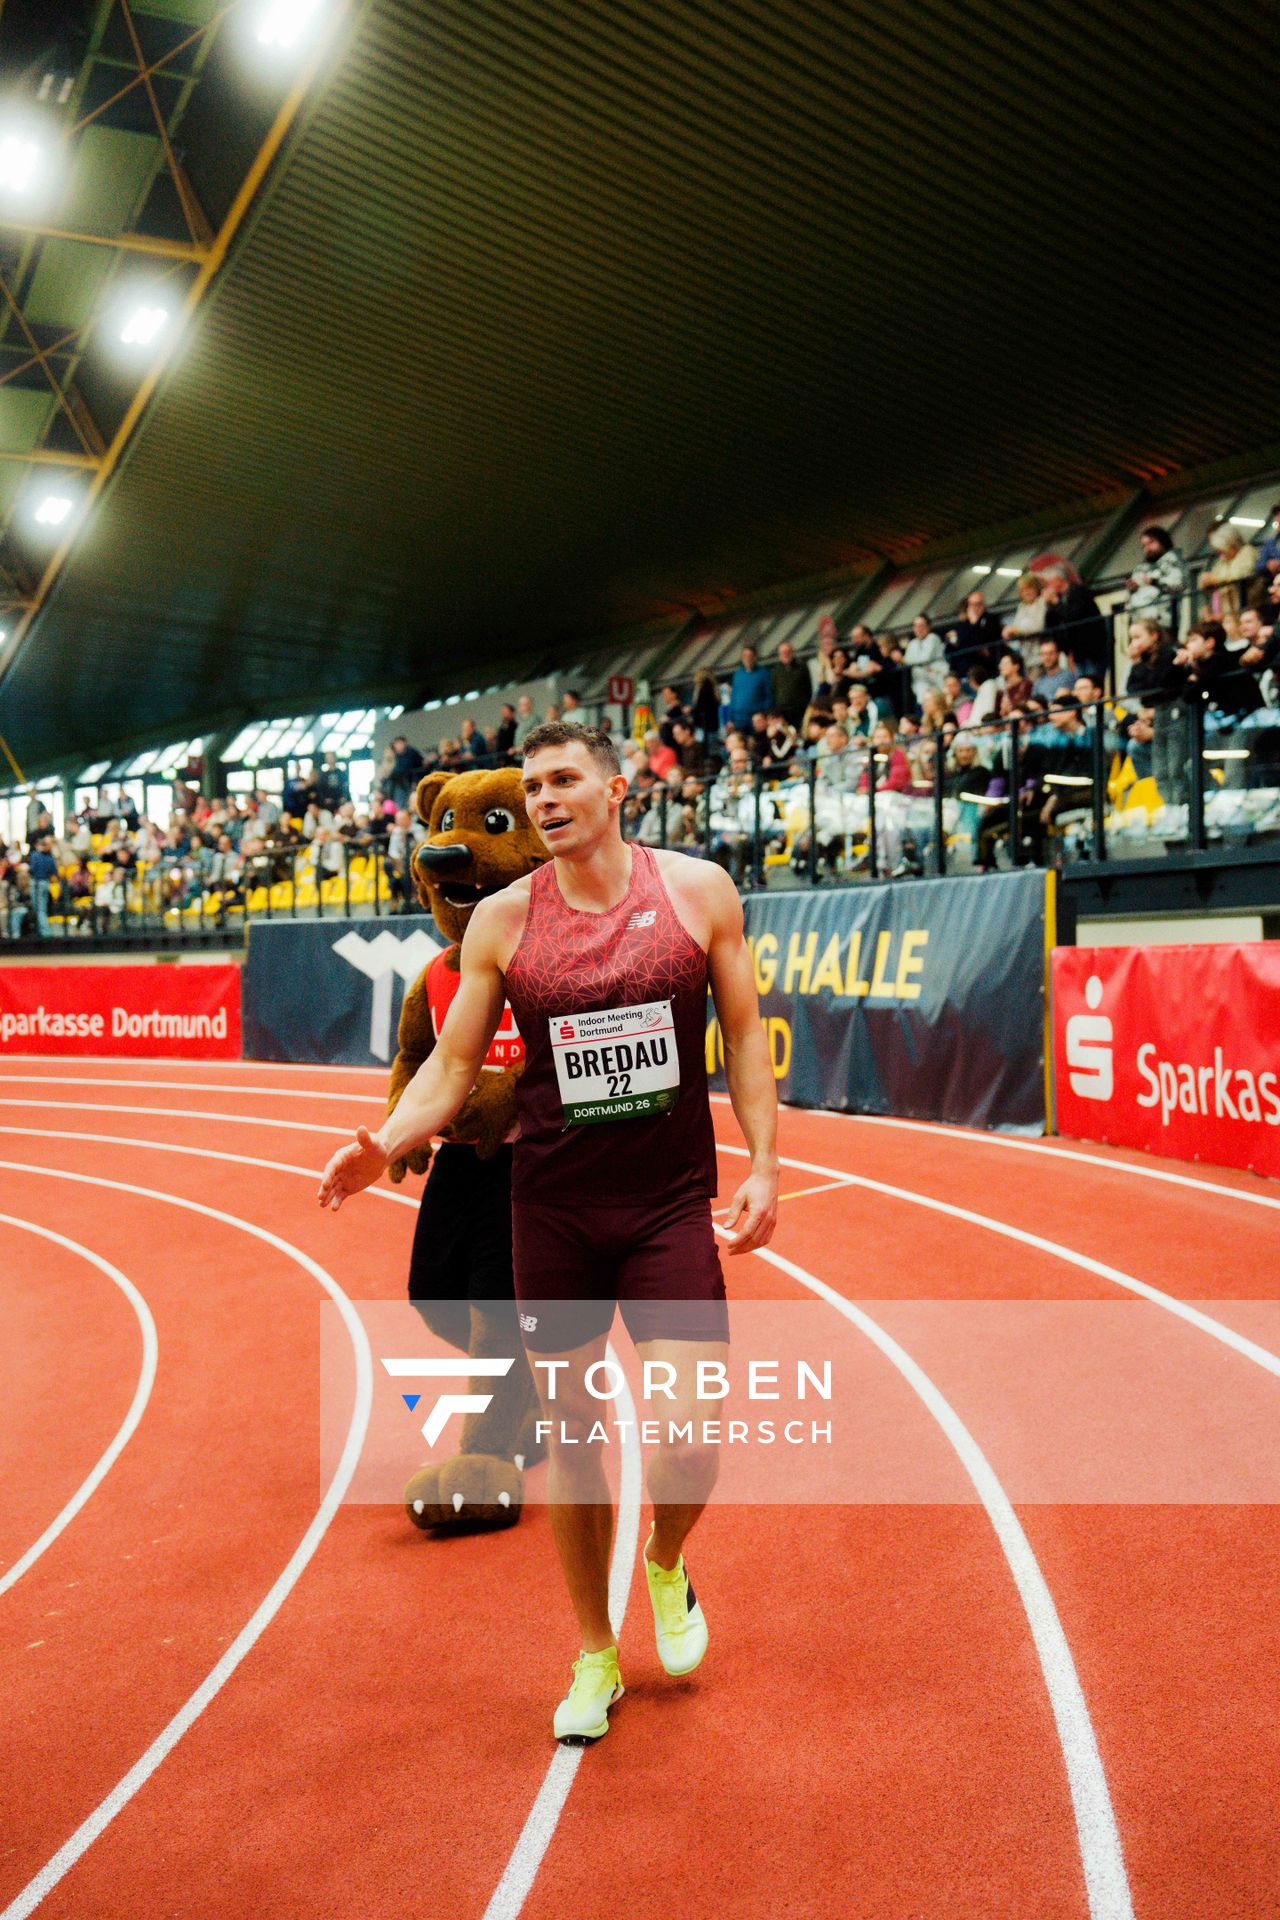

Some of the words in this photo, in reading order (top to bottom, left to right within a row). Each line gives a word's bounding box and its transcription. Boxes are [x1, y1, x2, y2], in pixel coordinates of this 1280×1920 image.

[784, 930, 930, 999] HALLE
[0, 1005, 105, 1043] parkasse
[111, 1006, 227, 1039] Dortmund
[578, 1016, 606, 1027] Indoor
[607, 1010, 643, 1023] Meeting
[580, 1024, 624, 1037] Dortmund
[564, 1037, 668, 1080] BREDAU
[606, 1073, 633, 1097] 22
[573, 1102, 634, 1118] DORTMUND
[635, 1099, 651, 1110] 26
